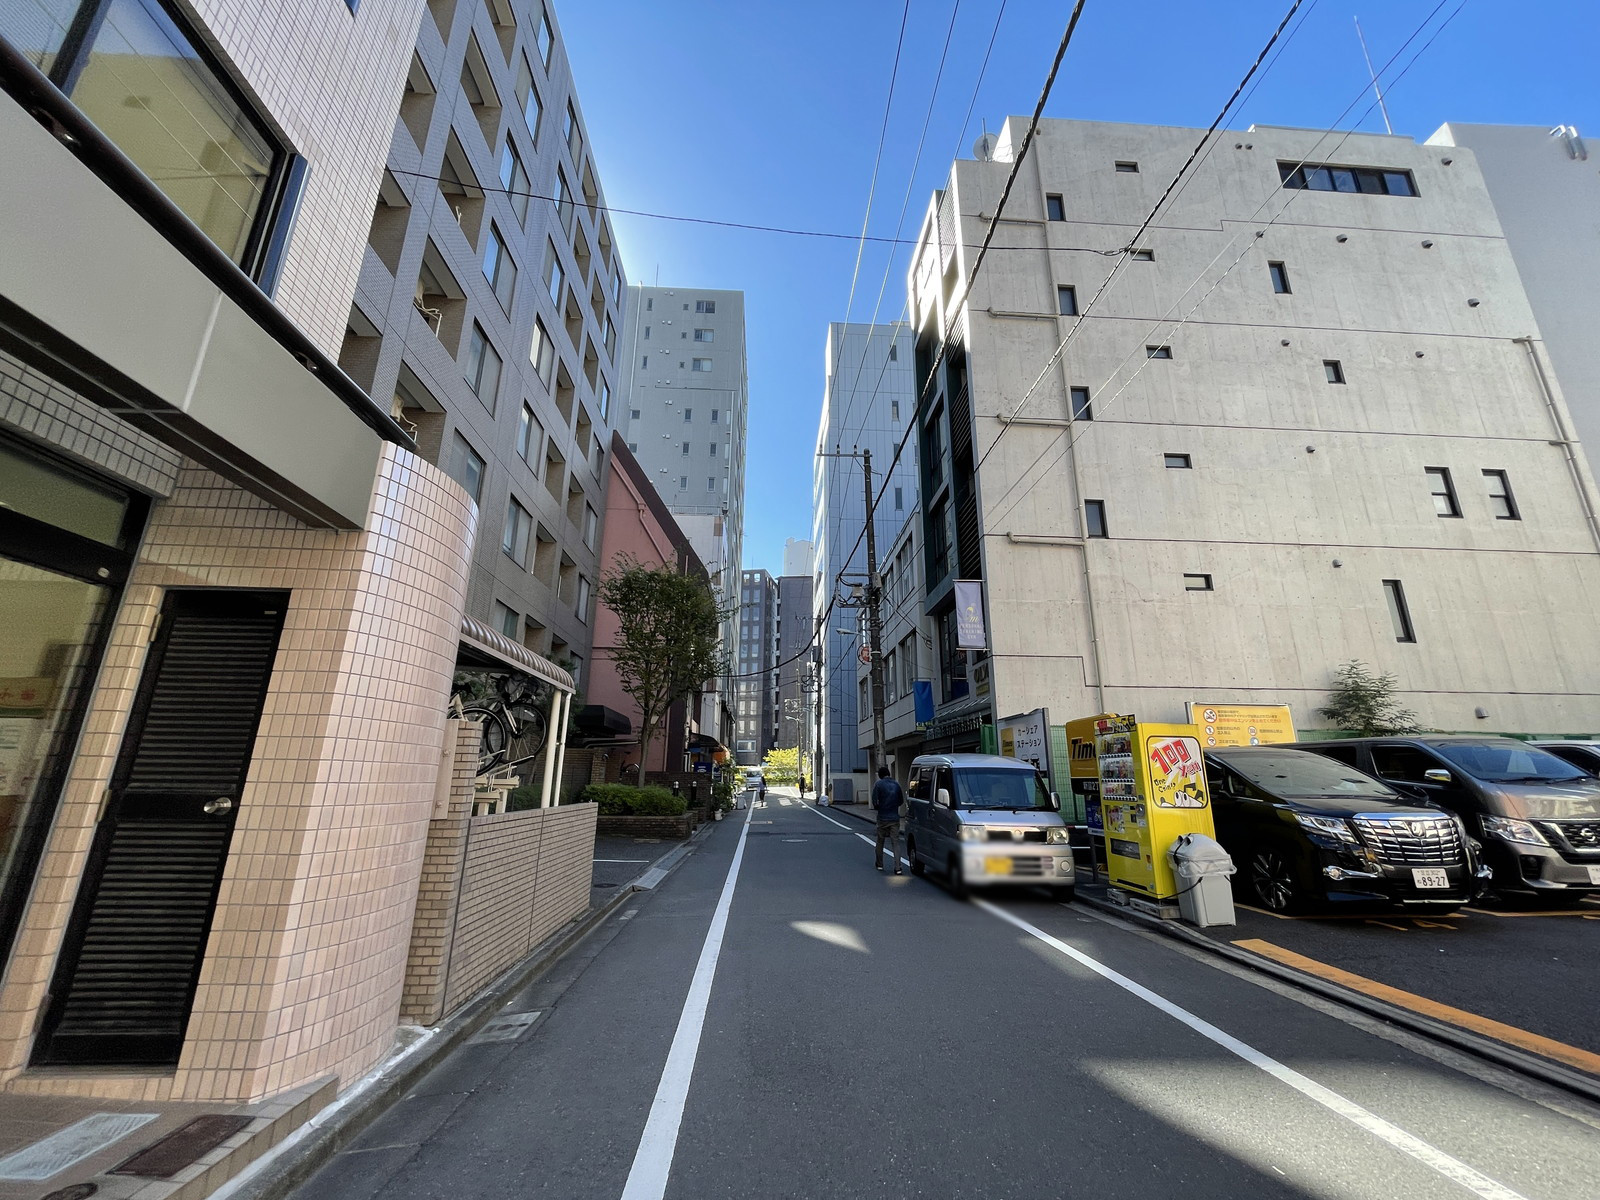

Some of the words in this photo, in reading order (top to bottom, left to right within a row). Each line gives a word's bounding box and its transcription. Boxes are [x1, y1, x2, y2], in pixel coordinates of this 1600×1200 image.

[1017, 724, 1038, 737] カーシェア
[1016, 738, 1042, 749] ステーション
[1151, 739, 1192, 776] 100
[1421, 876, 1446, 887] 89-27
